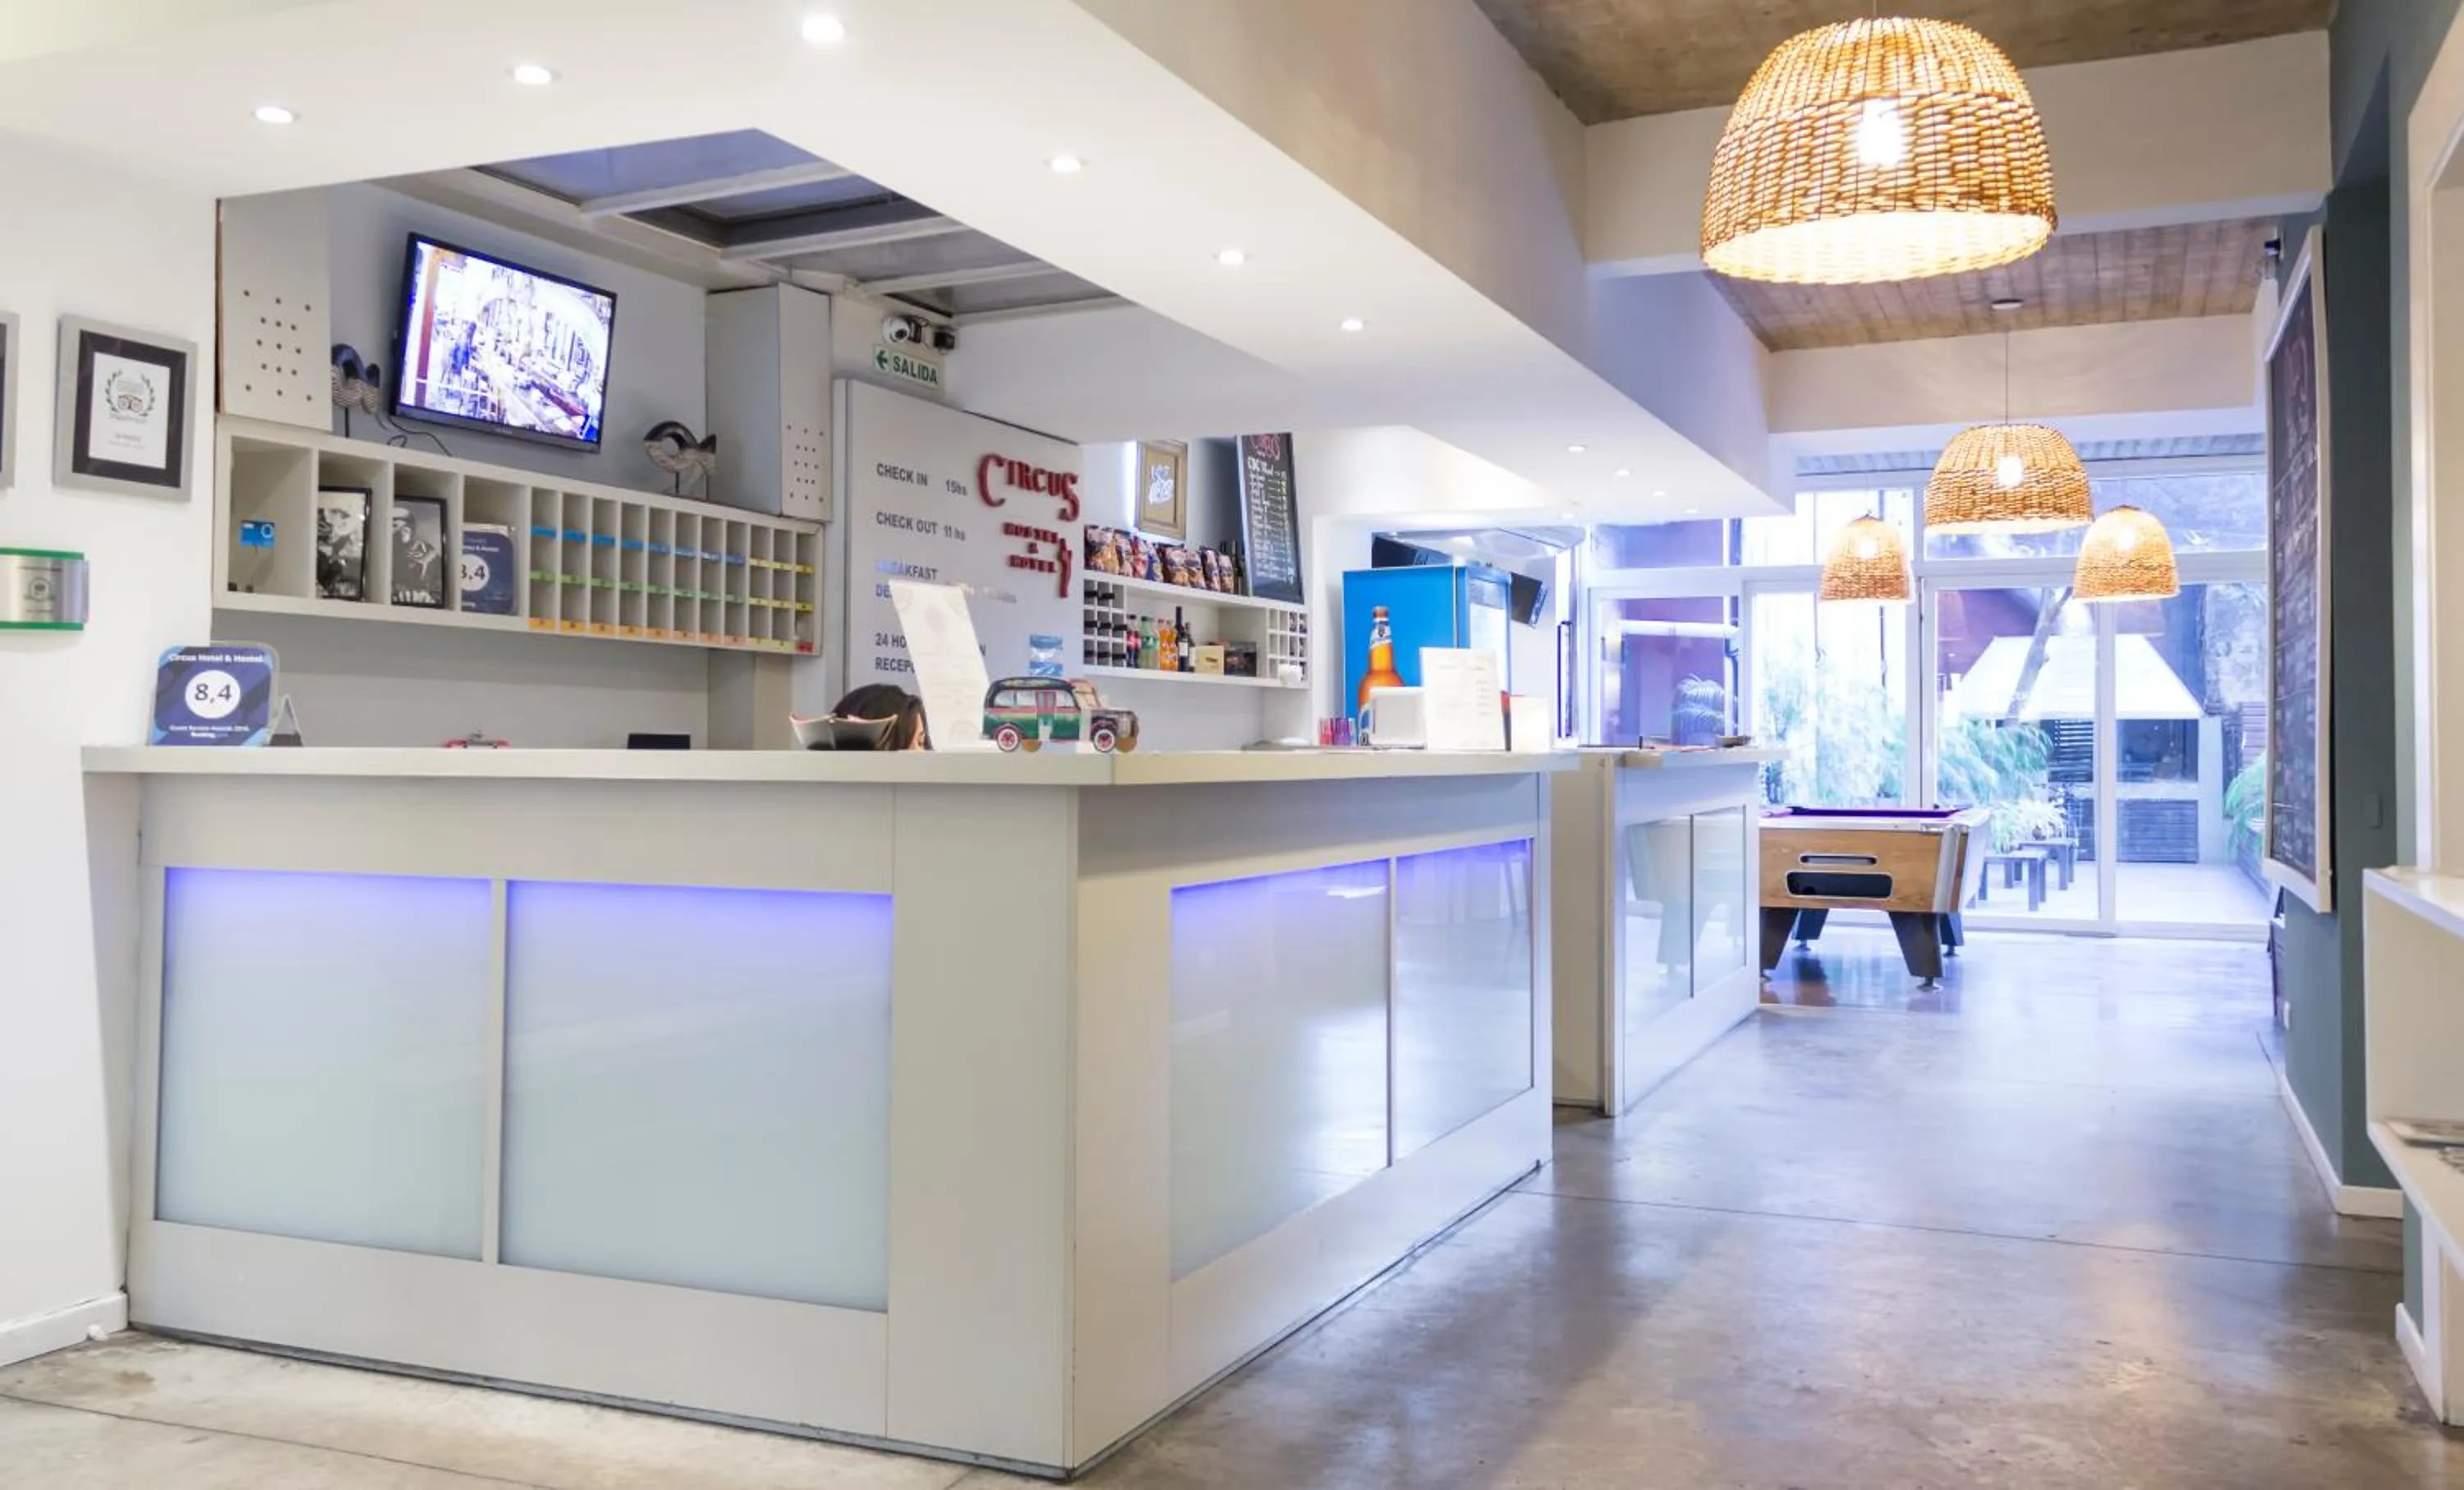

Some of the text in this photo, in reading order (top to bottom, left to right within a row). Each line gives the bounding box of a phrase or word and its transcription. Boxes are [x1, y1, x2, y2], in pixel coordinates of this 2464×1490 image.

[893, 355, 938, 384] SALIDA
[876, 462, 914, 485] CHECK
[916, 471, 928, 487] IN
[876, 511, 914, 531] CHECK
[916, 518, 938, 535] OUT
[944, 525, 952, 539] 11
[875, 632, 889, 647] 24
[194, 683, 232, 704] 8,4
